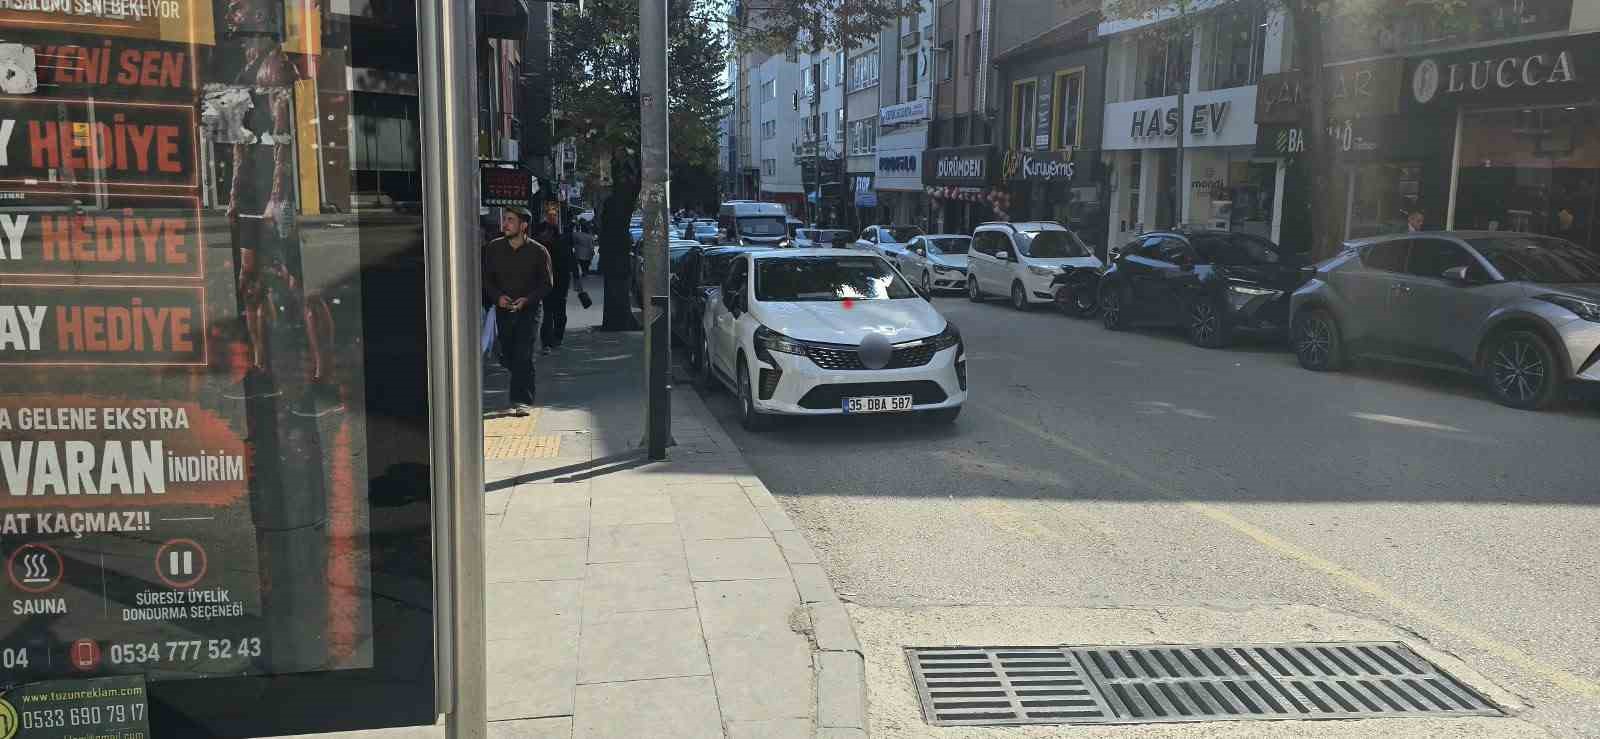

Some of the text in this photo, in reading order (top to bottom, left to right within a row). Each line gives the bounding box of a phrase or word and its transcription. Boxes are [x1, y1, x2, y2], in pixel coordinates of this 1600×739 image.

[35, 40, 184, 88] YENİ SEN
[1447, 50, 1576, 93] LUCCA
[1130, 100, 1230, 138] HAS EV
[27, 113, 183, 173] HEDİYE
[937, 155, 982, 177] DÜRÜMDEN
[40, 208, 188, 264] HEDİYE
[55, 297, 193, 352] HEDİYE
[849, 397, 911, 411] 35 DBA 587
[18, 407, 97, 430] GELENE
[103, 407, 190, 430] EKSTRA
[0, 440, 244, 496] VARAN İNDİRİM
[37, 511, 151, 539] KAÇMAZ!!
[12, 598, 68, 615] SAUNA
[136, 588, 231, 605] SÜRESİZ ÜYELİK
[123, 601, 244, 621] DONDURMA SEÇENEĞİ
[3, 648, 29, 668] 04
[111, 637, 262, 664] 0534 777 52 43
[23, 703, 144, 729] 0533 690 79 17
